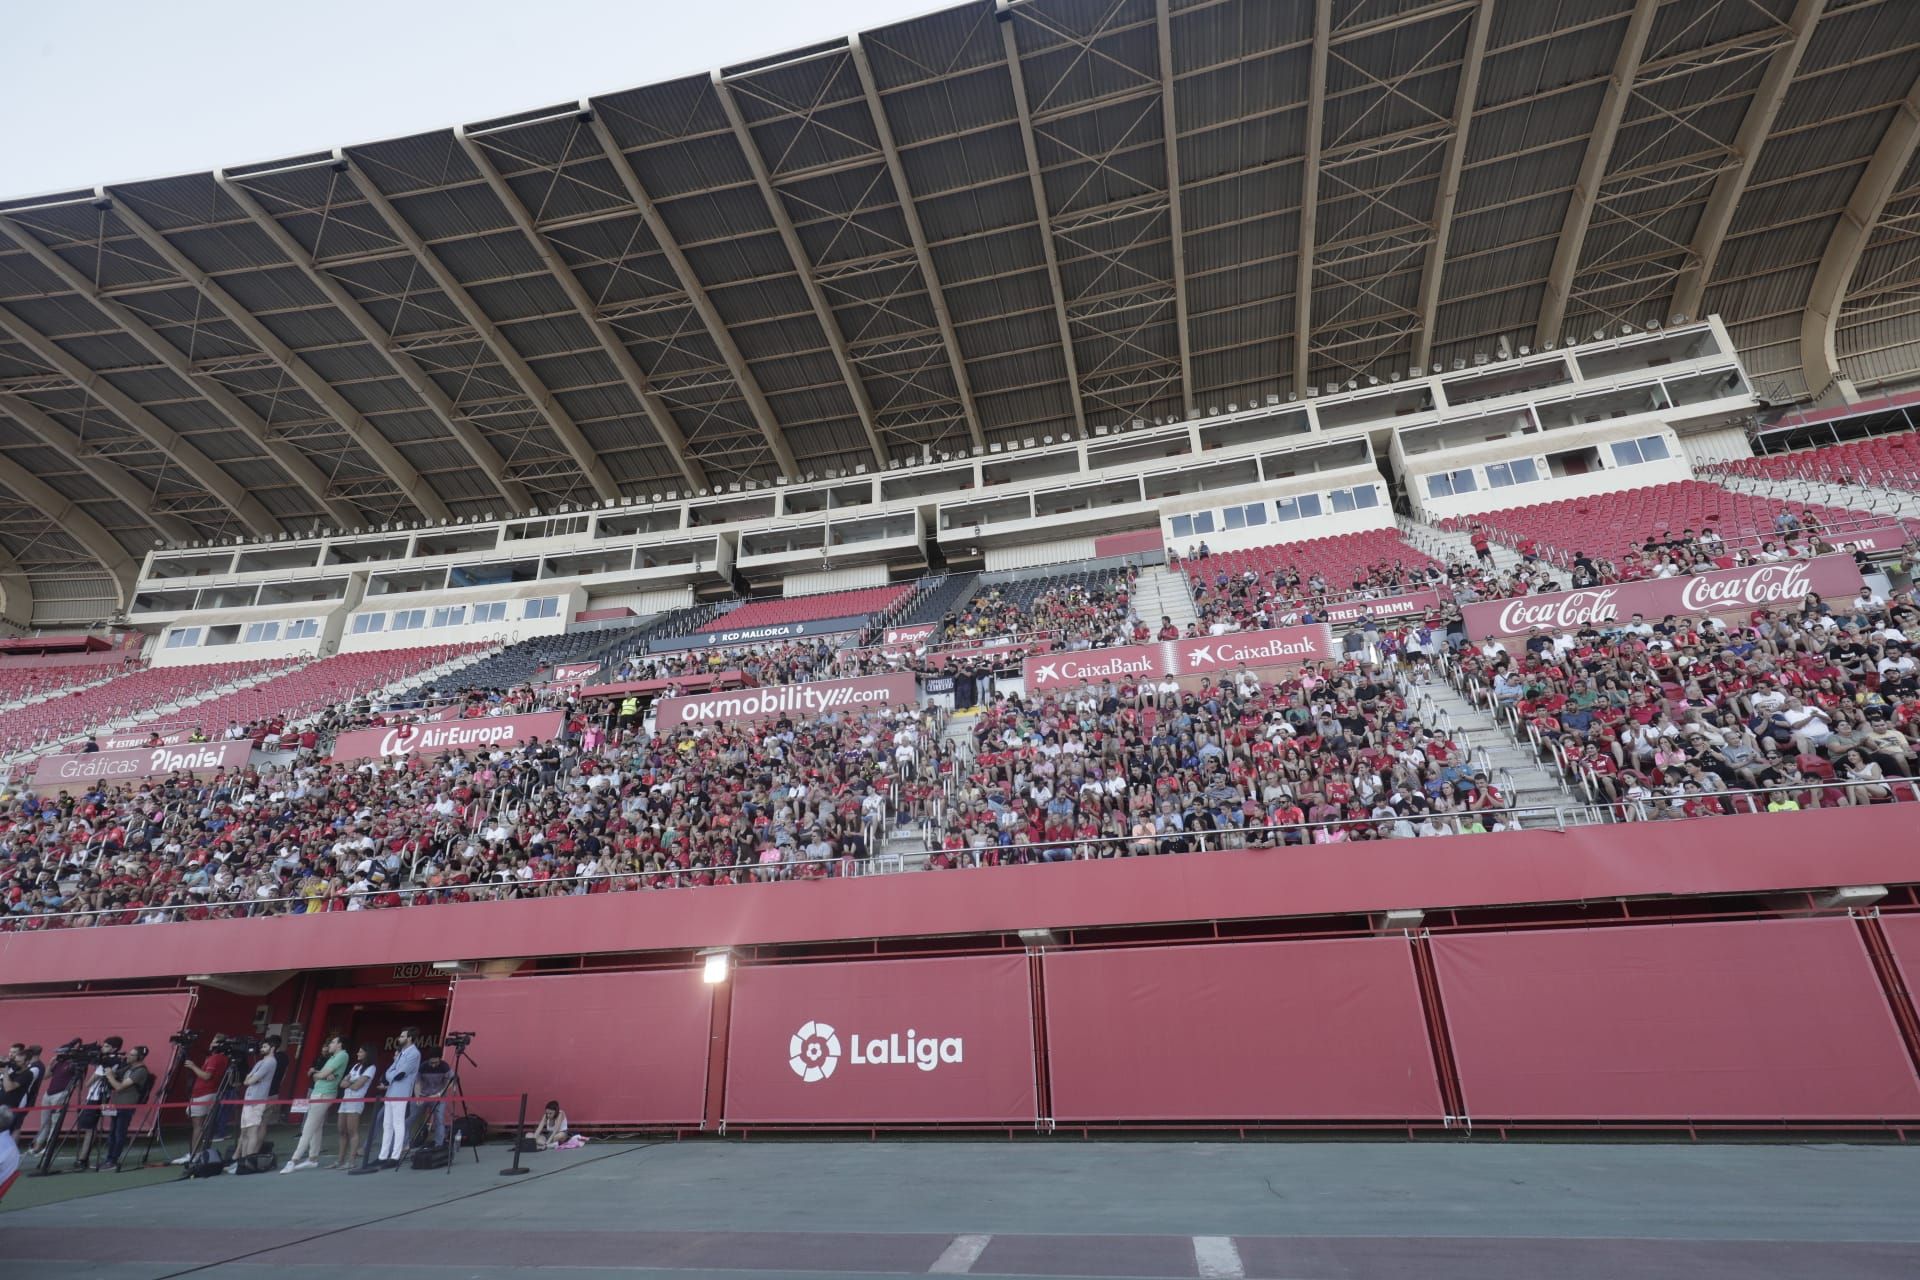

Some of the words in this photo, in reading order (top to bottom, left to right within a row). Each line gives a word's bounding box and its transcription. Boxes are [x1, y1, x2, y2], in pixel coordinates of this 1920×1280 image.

[1681, 562, 1812, 611] Coca-Cola
[1375, 601, 1414, 615] DAMM
[1499, 588, 1618, 634] Coca-Cola
[722, 632, 740, 642] RCD
[741, 627, 790, 640] MALLORCA
[1217, 637, 1317, 662] CaixaBank
[1061, 655, 1154, 680] CaixaBank
[420, 723, 514, 748] AirEuropa
[60, 757, 140, 779] Gráficas
[150, 745, 226, 773] Planisi
[393, 963, 422, 979] RCD
[850, 1028, 963, 1072] LaLiga
